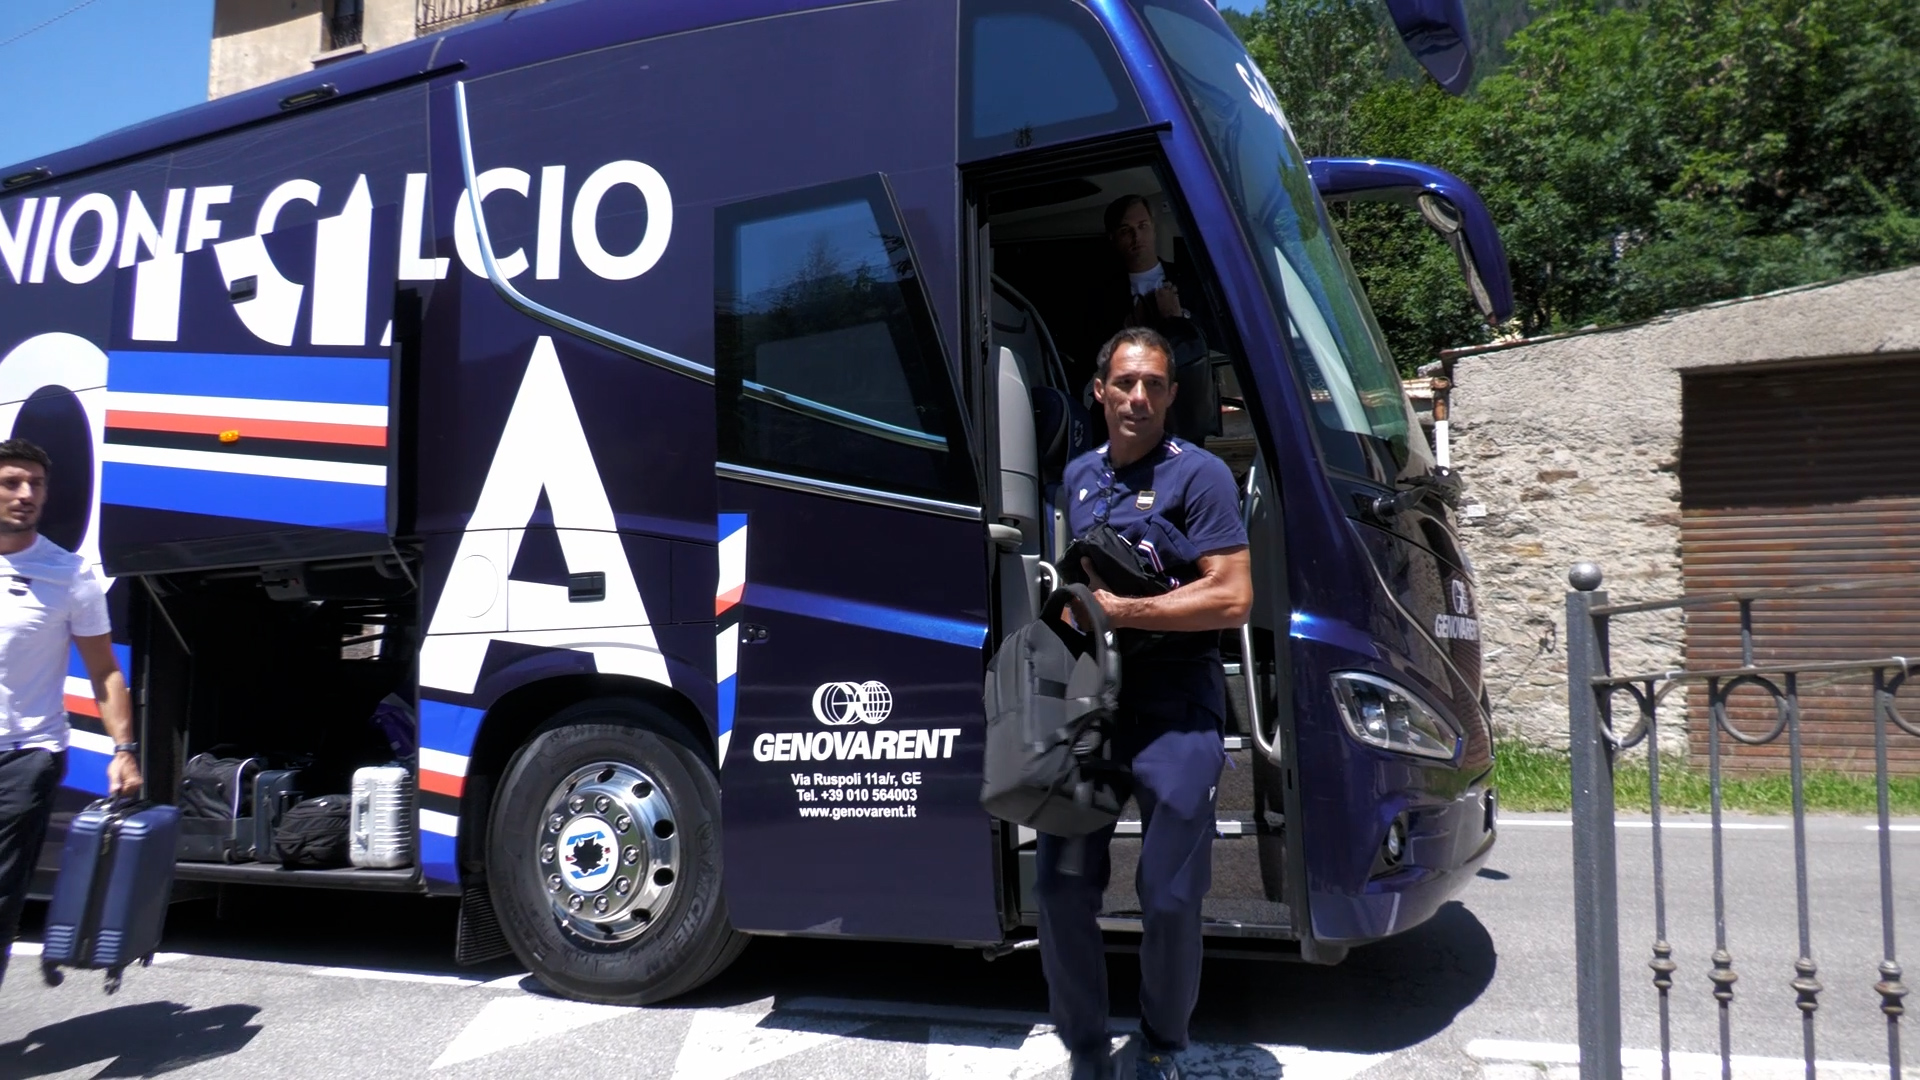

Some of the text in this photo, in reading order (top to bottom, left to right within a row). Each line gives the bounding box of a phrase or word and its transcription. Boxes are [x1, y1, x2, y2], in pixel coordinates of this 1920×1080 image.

[1434, 613, 1479, 641] GENOVARE
[753, 728, 961, 762] GENOVARENT
[791, 772, 922, 788] Via Ruspoli 11a/r, GE
[796, 787, 917, 801] Tel. +39 010 564003
[799, 805, 916, 820] www.genovarent.it
